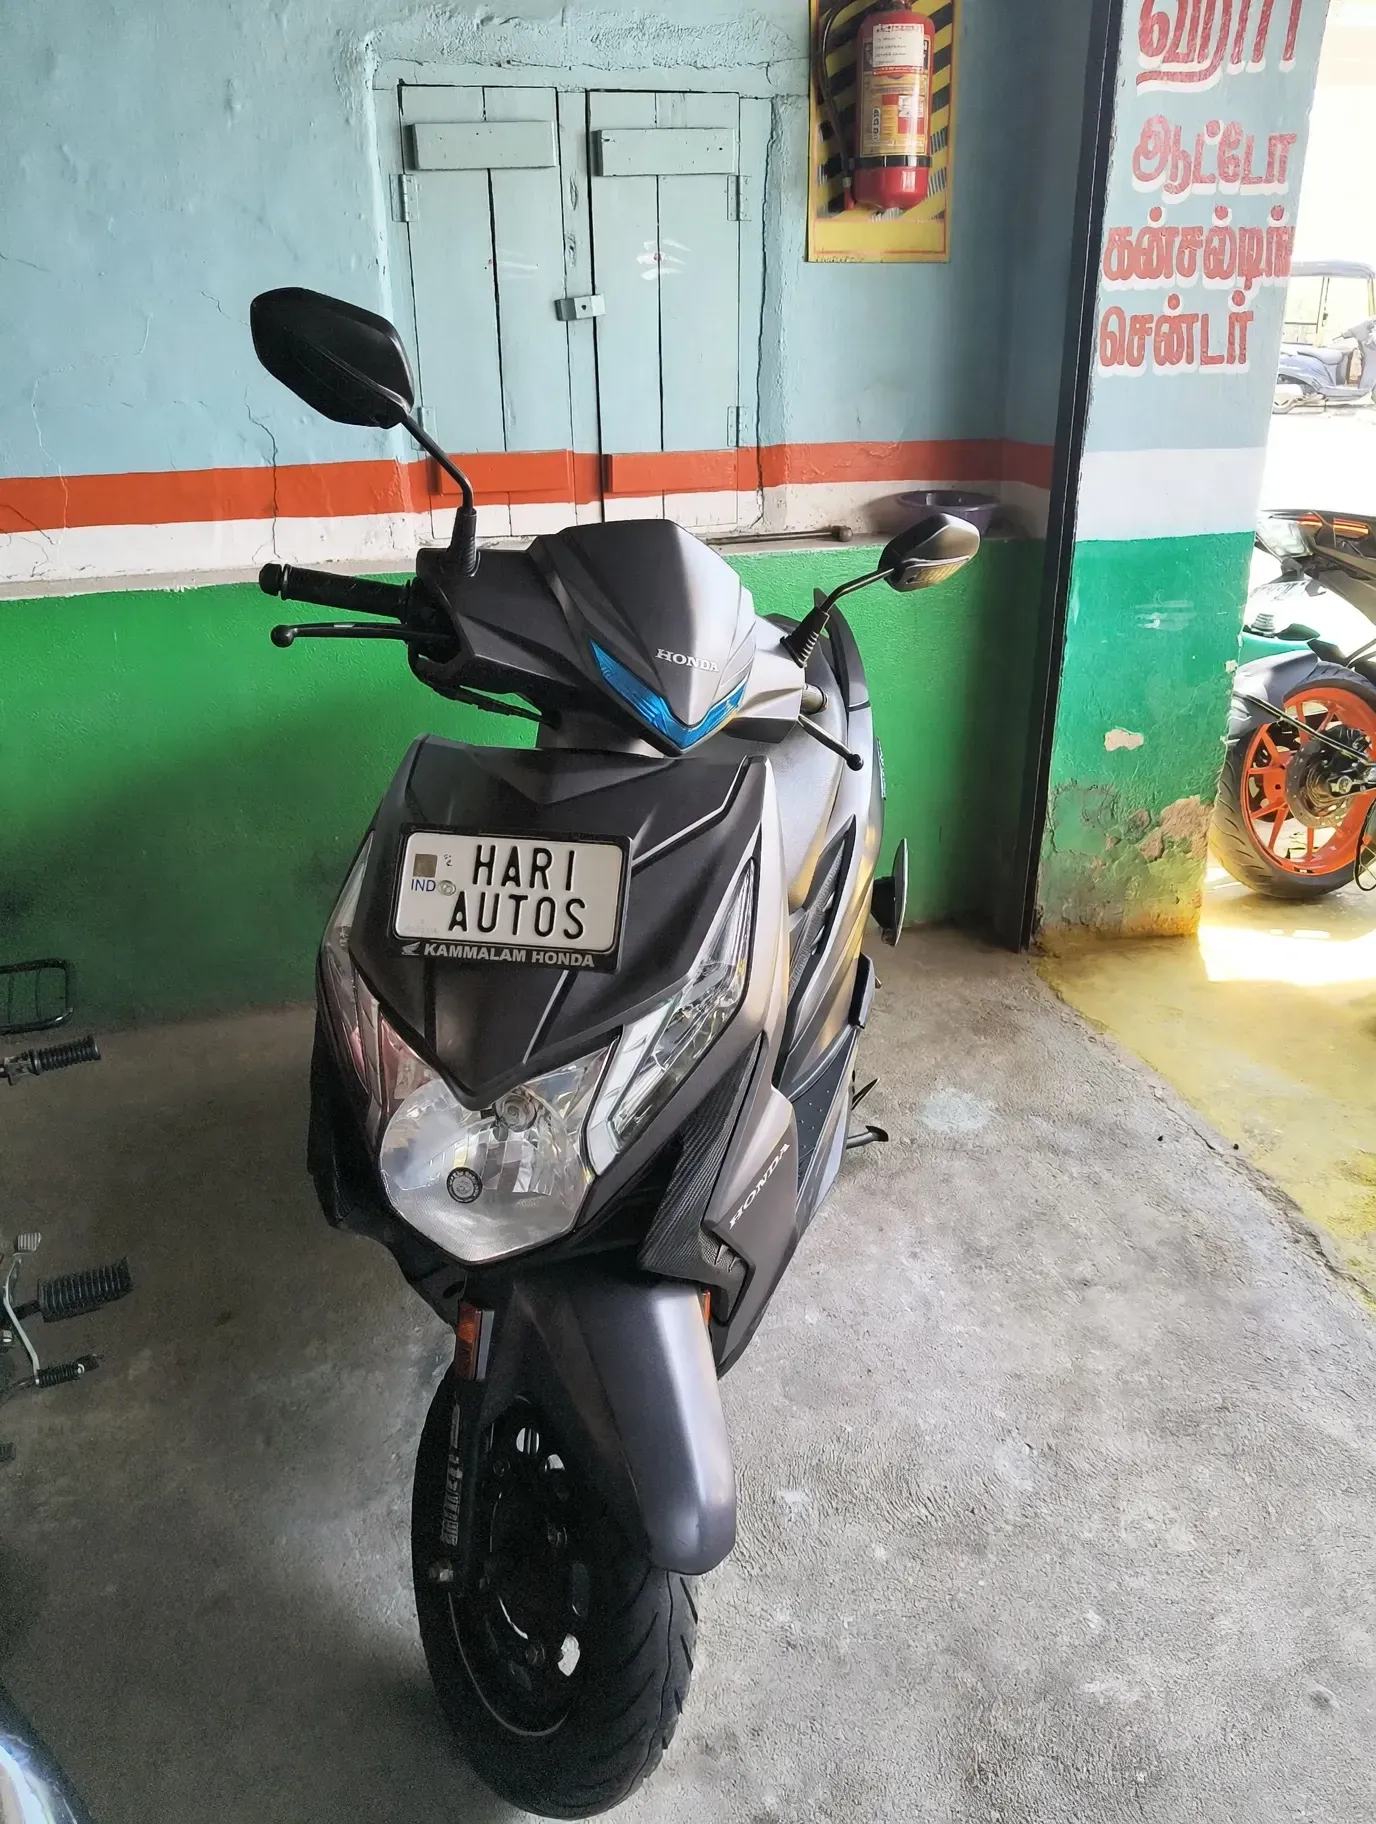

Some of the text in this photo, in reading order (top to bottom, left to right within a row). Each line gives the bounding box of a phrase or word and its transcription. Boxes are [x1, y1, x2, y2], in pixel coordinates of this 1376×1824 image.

[1132, 114, 1298, 195] ஆட்டோ
[1100, 289, 1254, 367] சென்டர்
[655, 648, 719, 672] HONDA
[410, 878, 437, 892] IND
[472, 844, 576, 892] HARI
[448, 890, 586, 940] AUTOS
[423, 942, 595, 968] KAMMALAM HONDA
[728, 1143, 791, 1230] HONDA
